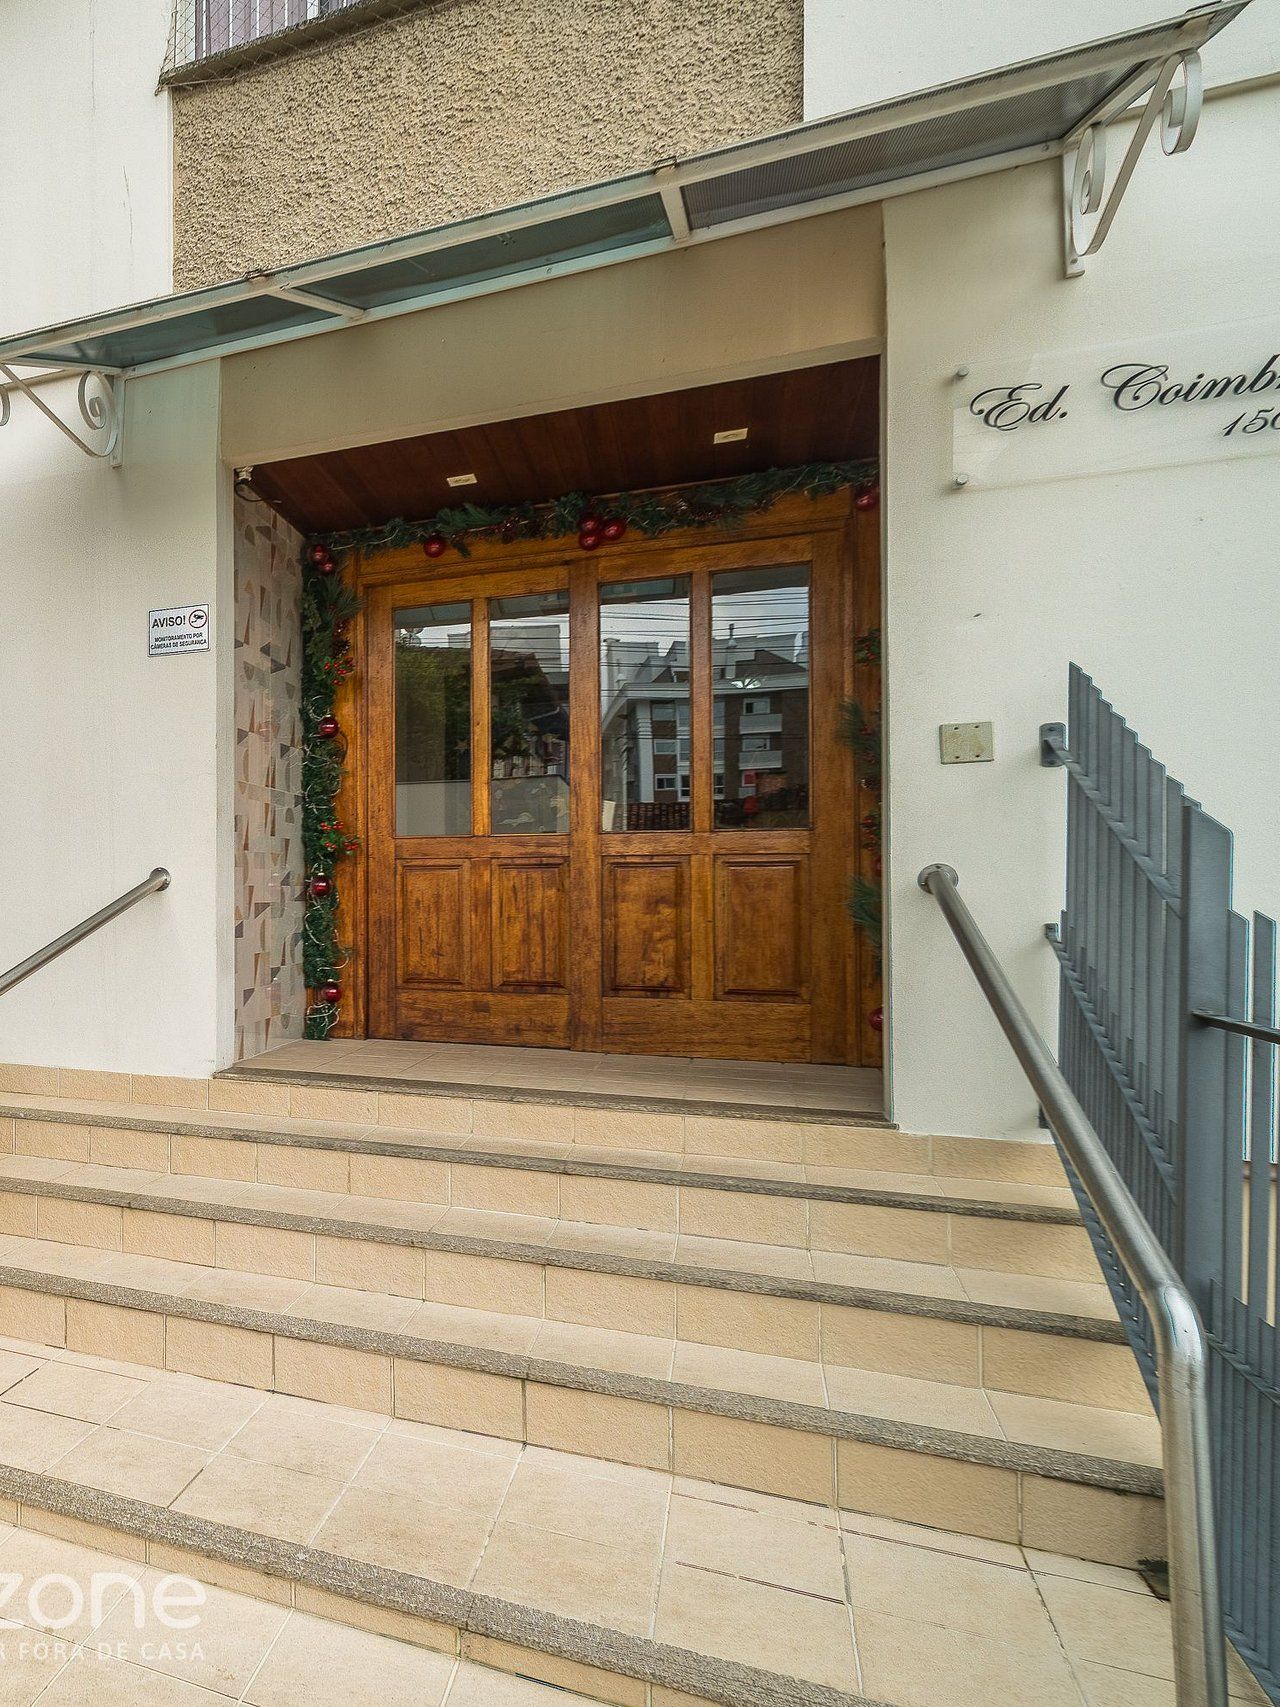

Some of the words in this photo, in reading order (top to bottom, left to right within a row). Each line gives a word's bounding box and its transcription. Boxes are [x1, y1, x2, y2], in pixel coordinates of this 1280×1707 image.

[969, 382, 1071, 431] Ed.
[1101, 353, 1280, 411] Coimb
[151, 615, 186, 628] AVISO!
[154, 633, 192, 643] MONITORAMENTO
